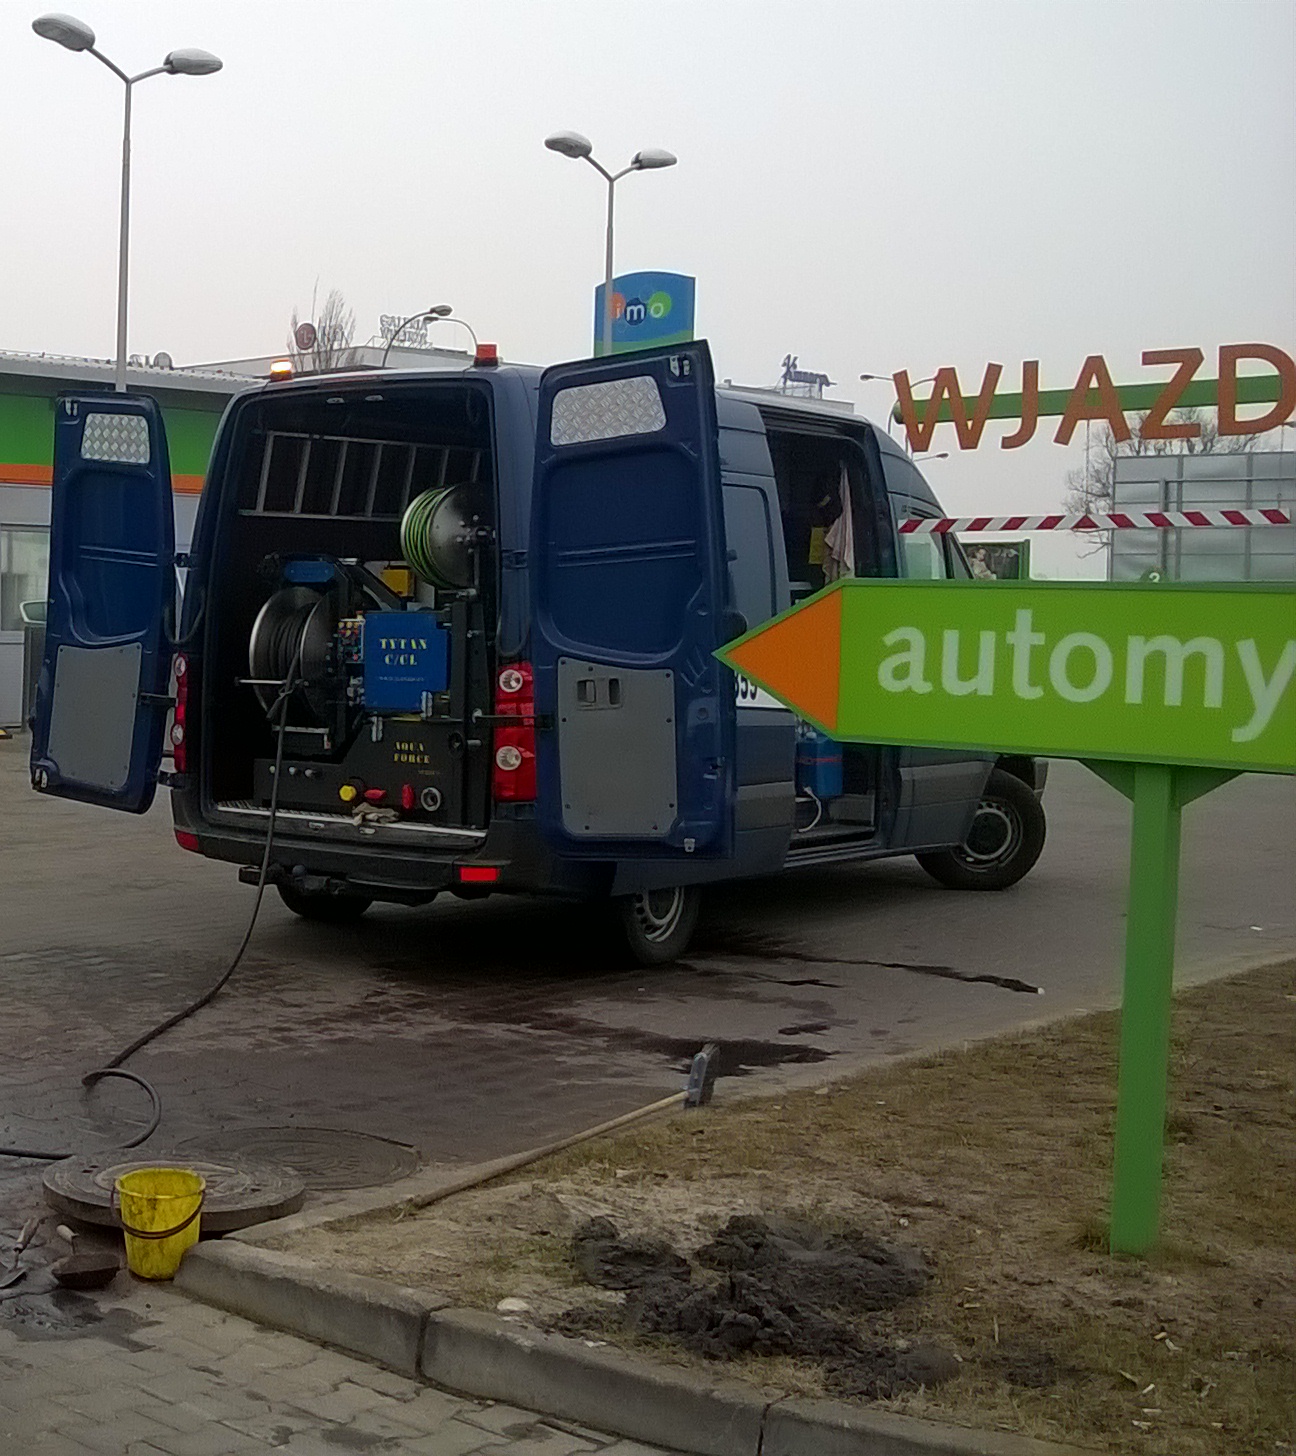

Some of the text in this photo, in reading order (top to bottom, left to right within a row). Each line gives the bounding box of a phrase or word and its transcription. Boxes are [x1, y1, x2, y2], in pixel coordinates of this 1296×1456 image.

[615, 302, 664, 321] imo
[893, 343, 1296, 453] WJAZD
[379, 638, 428, 650] TYTAN
[877, 609, 1296, 743] automy
